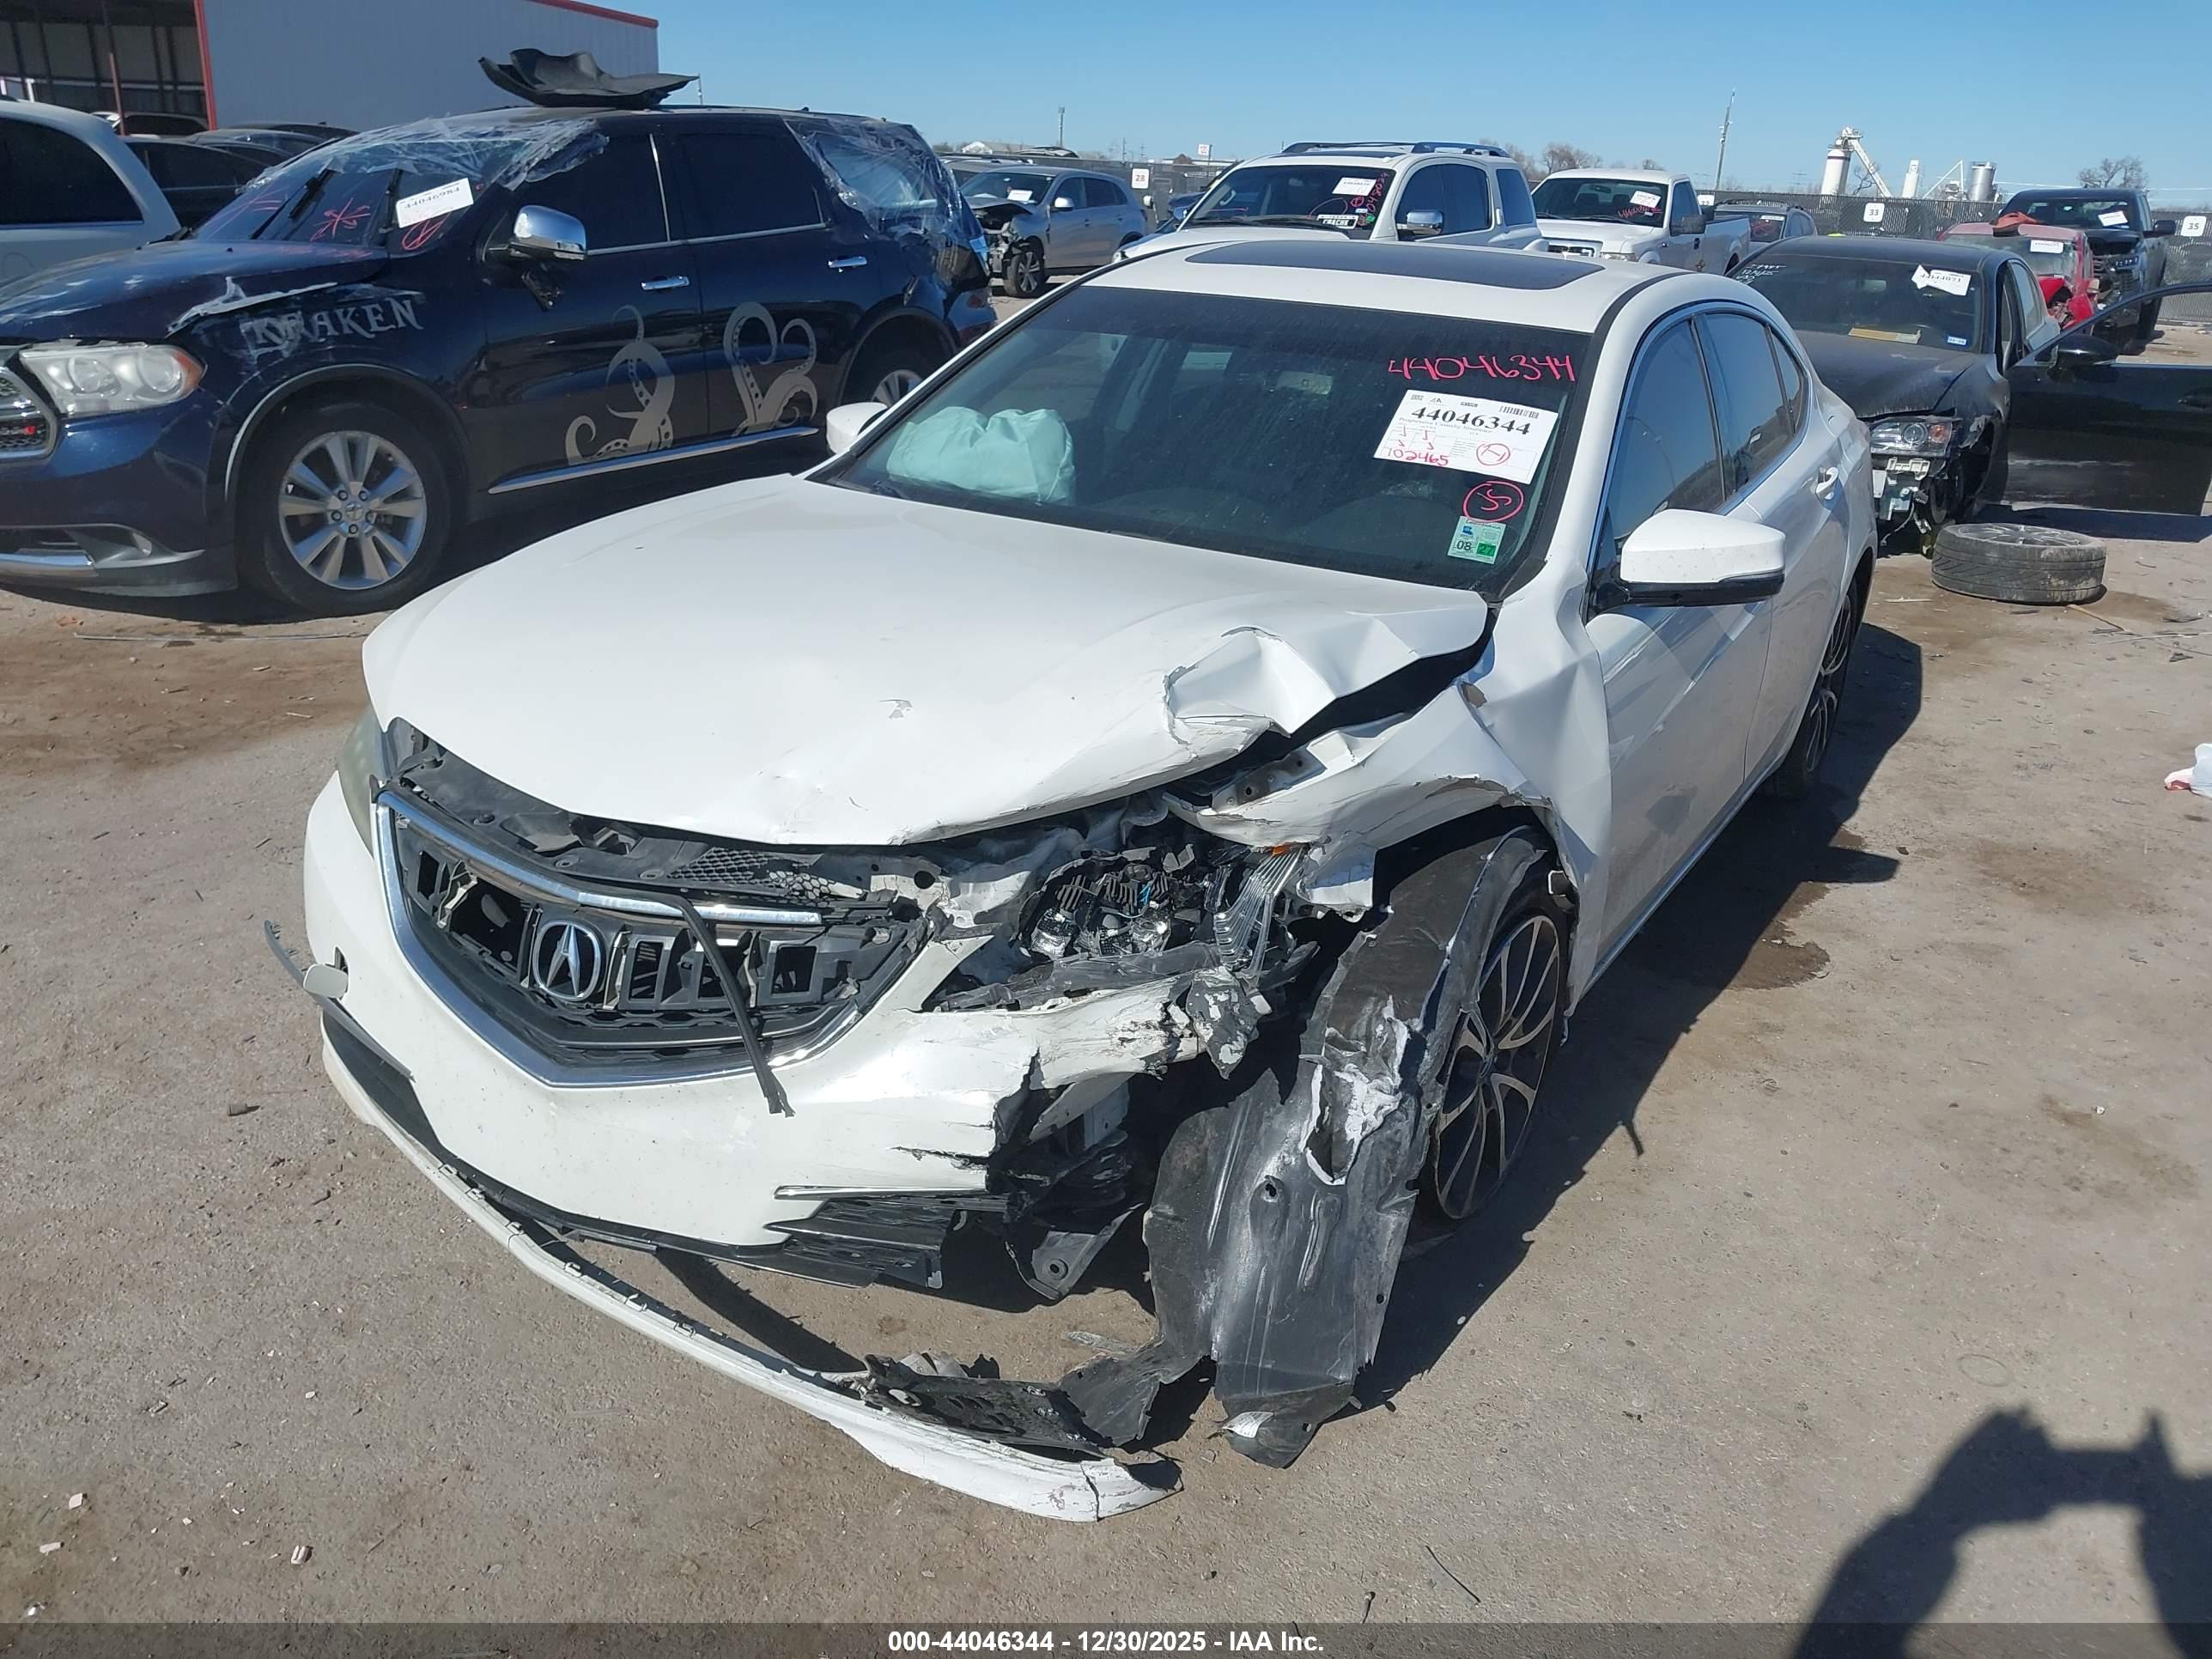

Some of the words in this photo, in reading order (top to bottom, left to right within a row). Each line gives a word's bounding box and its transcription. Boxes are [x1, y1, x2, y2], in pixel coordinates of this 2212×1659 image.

[249, 297, 424, 345] KRAKEN
[1388, 355, 1576, 382] 44046344
[1411, 406, 1532, 435] 44046344
[1456, 540, 1472, 551] 08
[1479, 544, 1493, 556] 27
